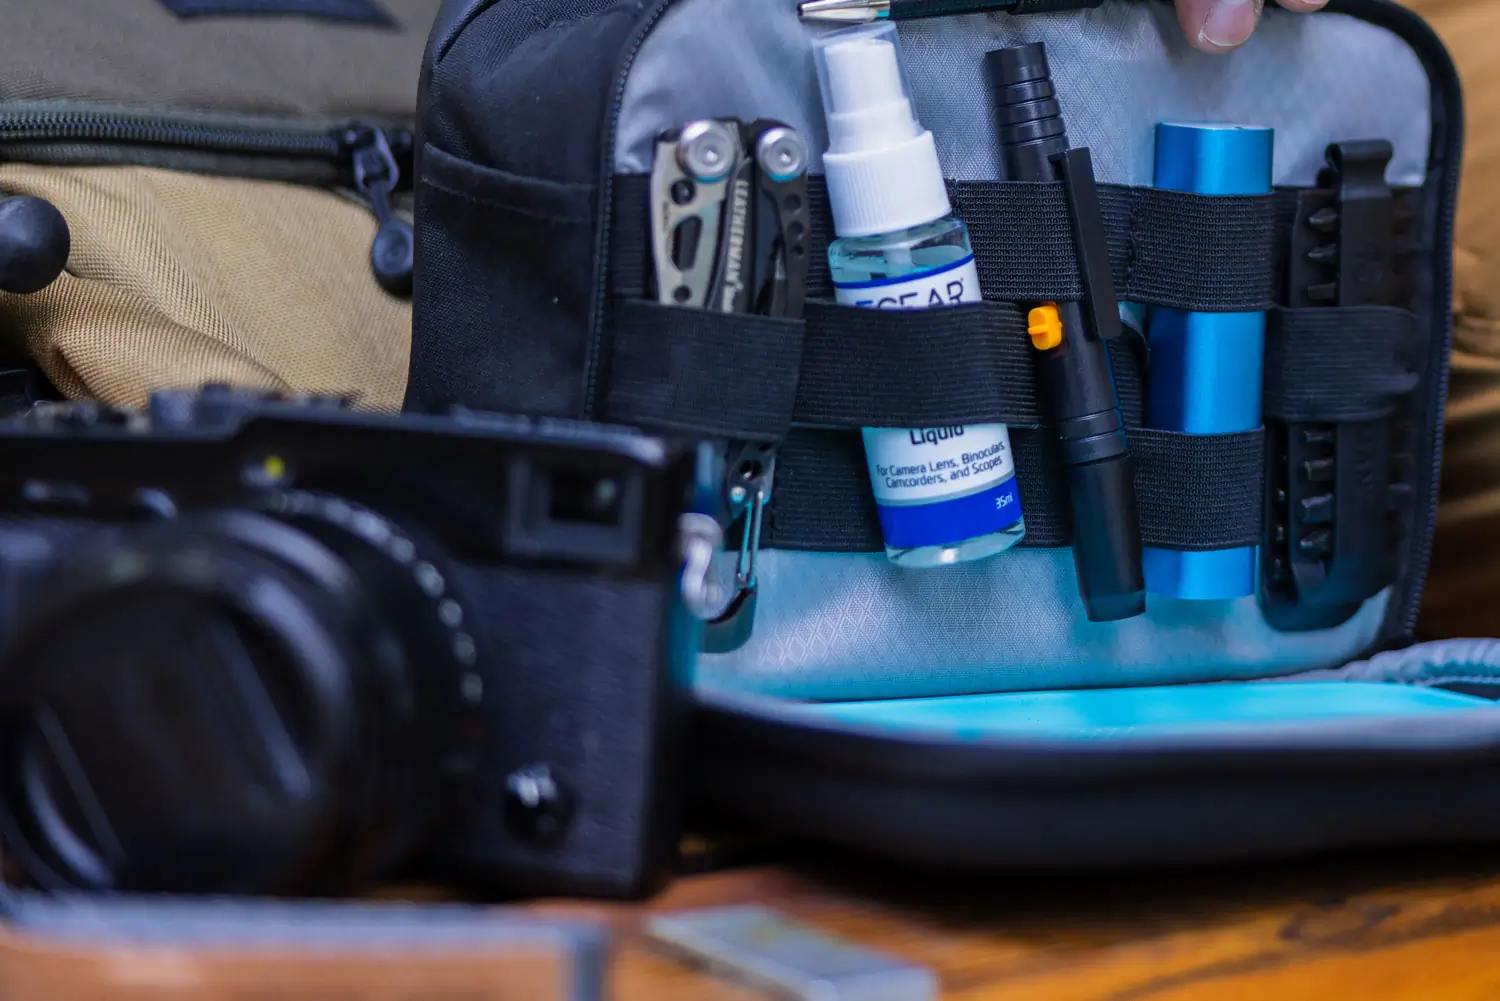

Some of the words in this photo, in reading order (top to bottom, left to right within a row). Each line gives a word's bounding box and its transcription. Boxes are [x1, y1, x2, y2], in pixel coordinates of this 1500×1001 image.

[876, 464, 887, 476] For
[889, 464, 927, 477] Camera
[950, 468, 970, 481] and
[972, 456, 1002, 474] Scopes
